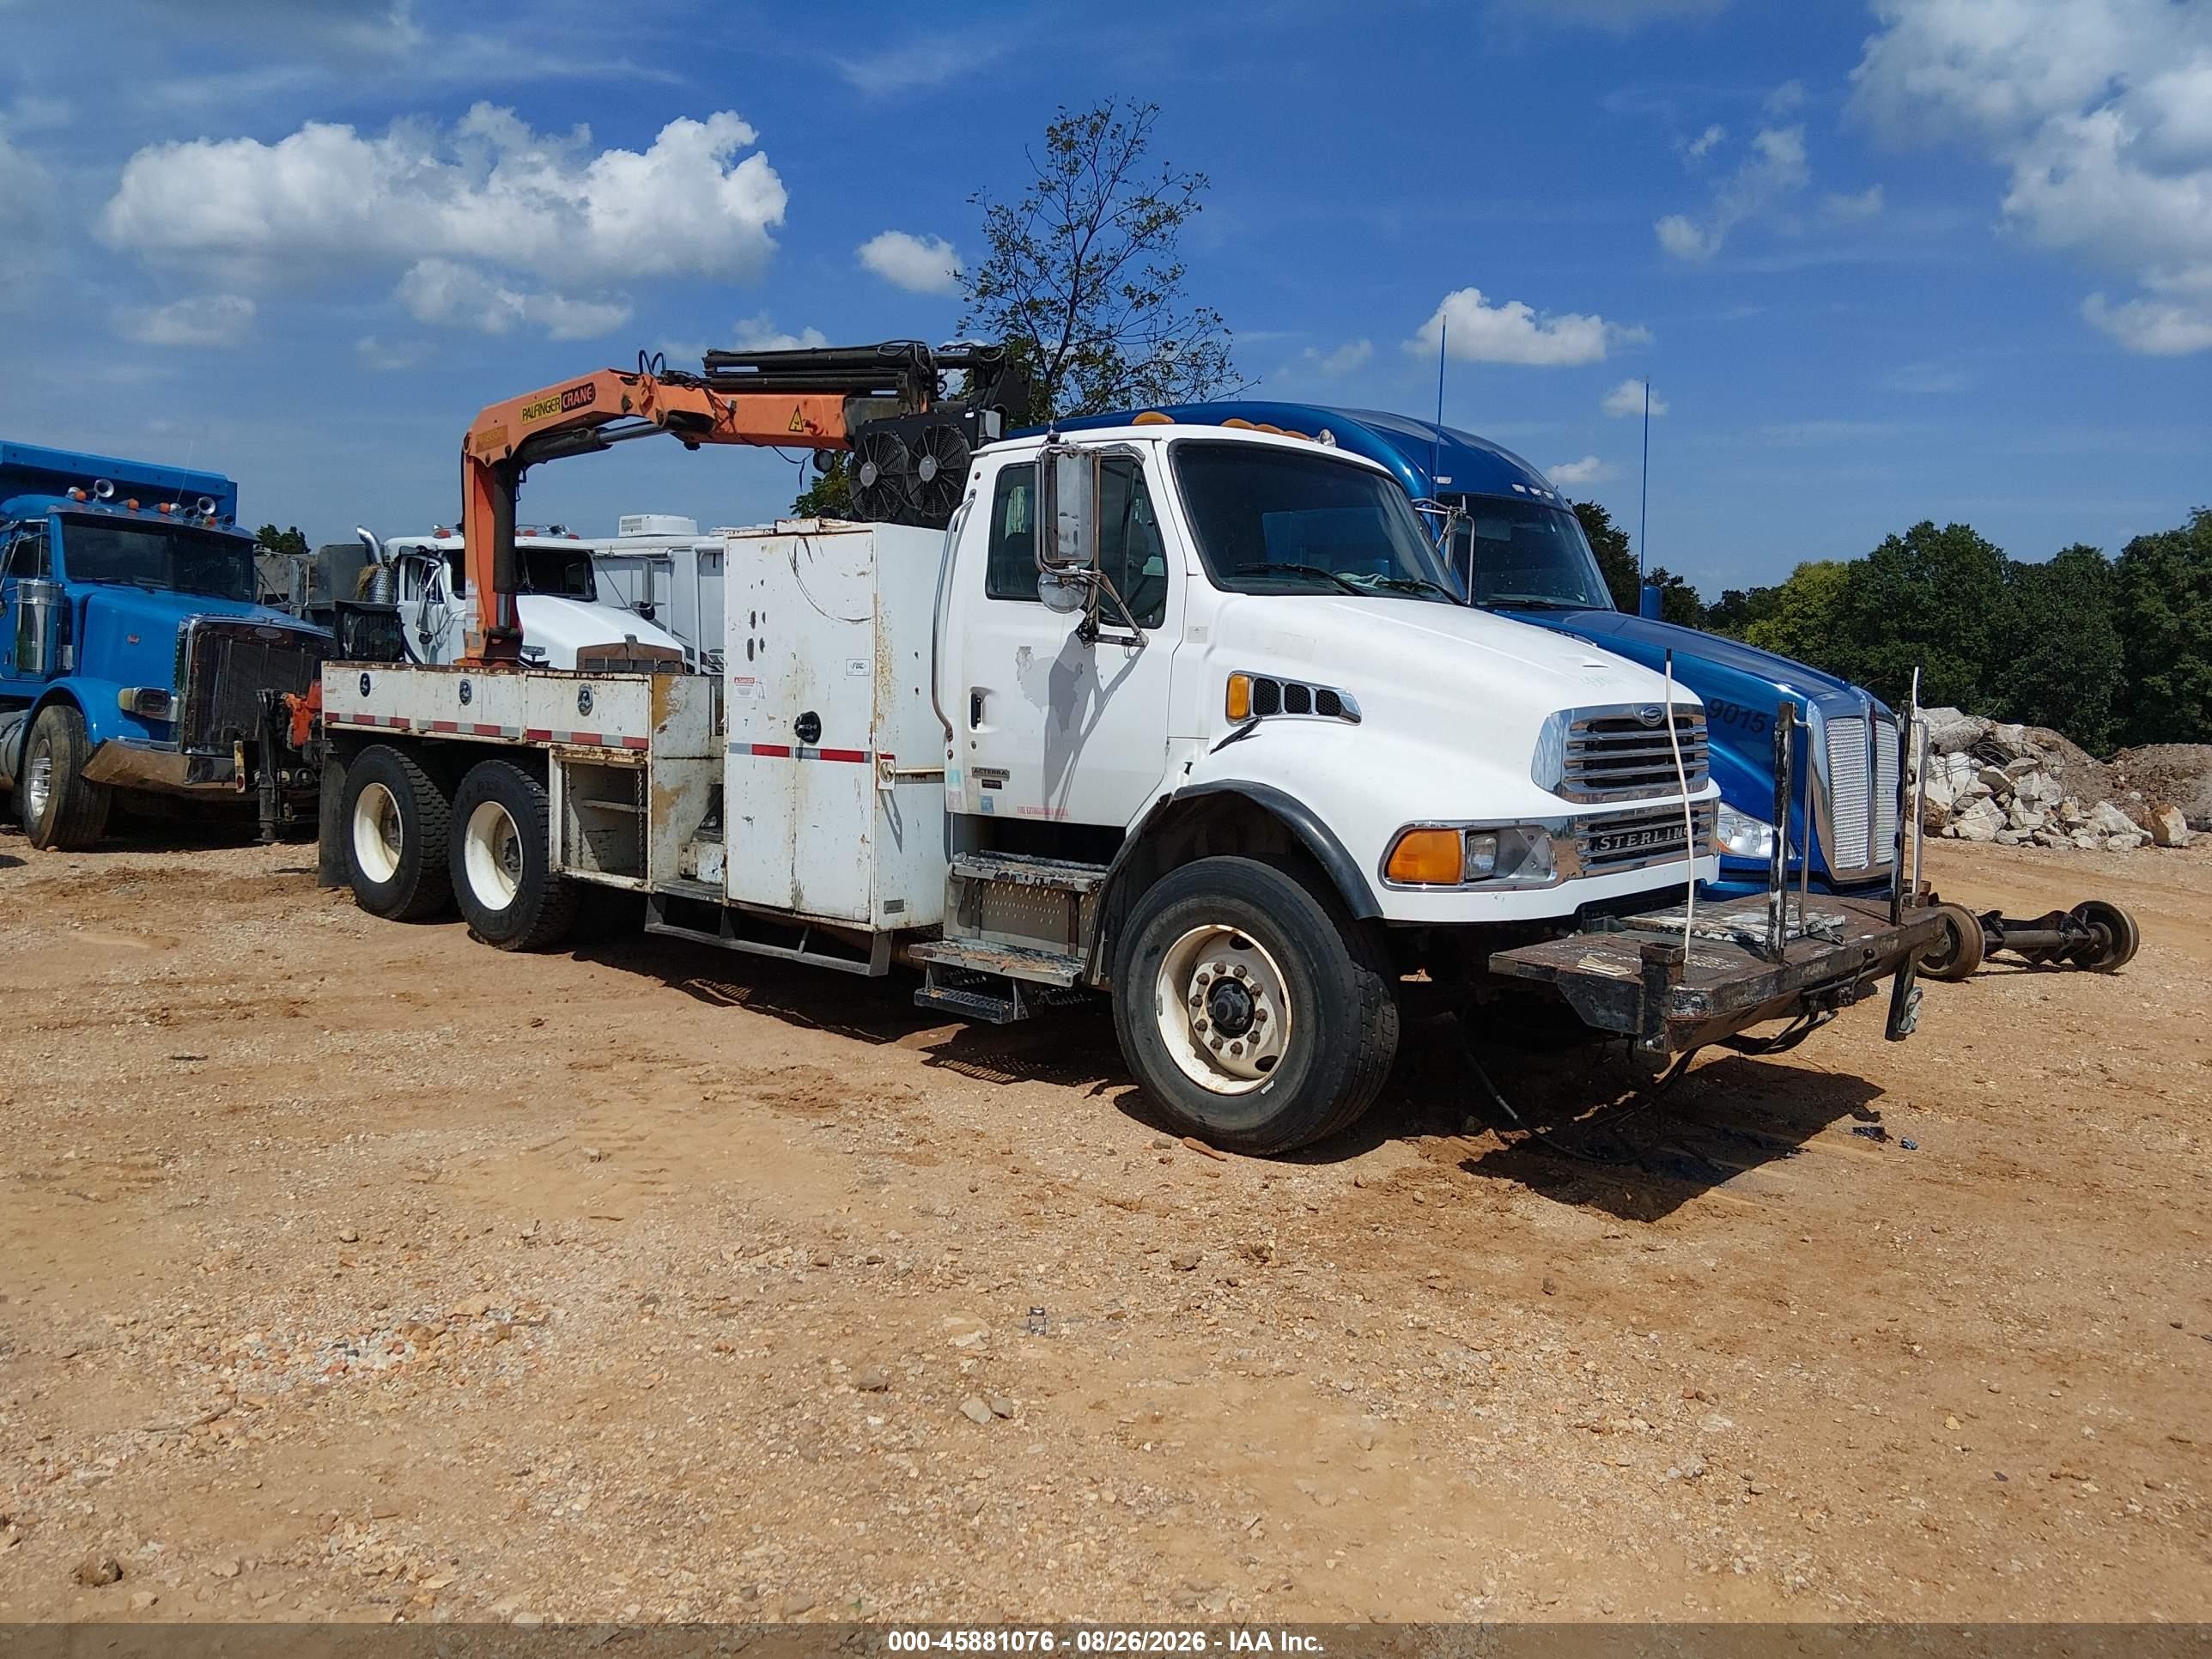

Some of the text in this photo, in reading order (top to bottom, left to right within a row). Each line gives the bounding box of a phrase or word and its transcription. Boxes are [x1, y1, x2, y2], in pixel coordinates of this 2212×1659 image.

[522, 385, 593, 422] PALFINGER CRANE
[1707, 698, 1768, 733] 9015
